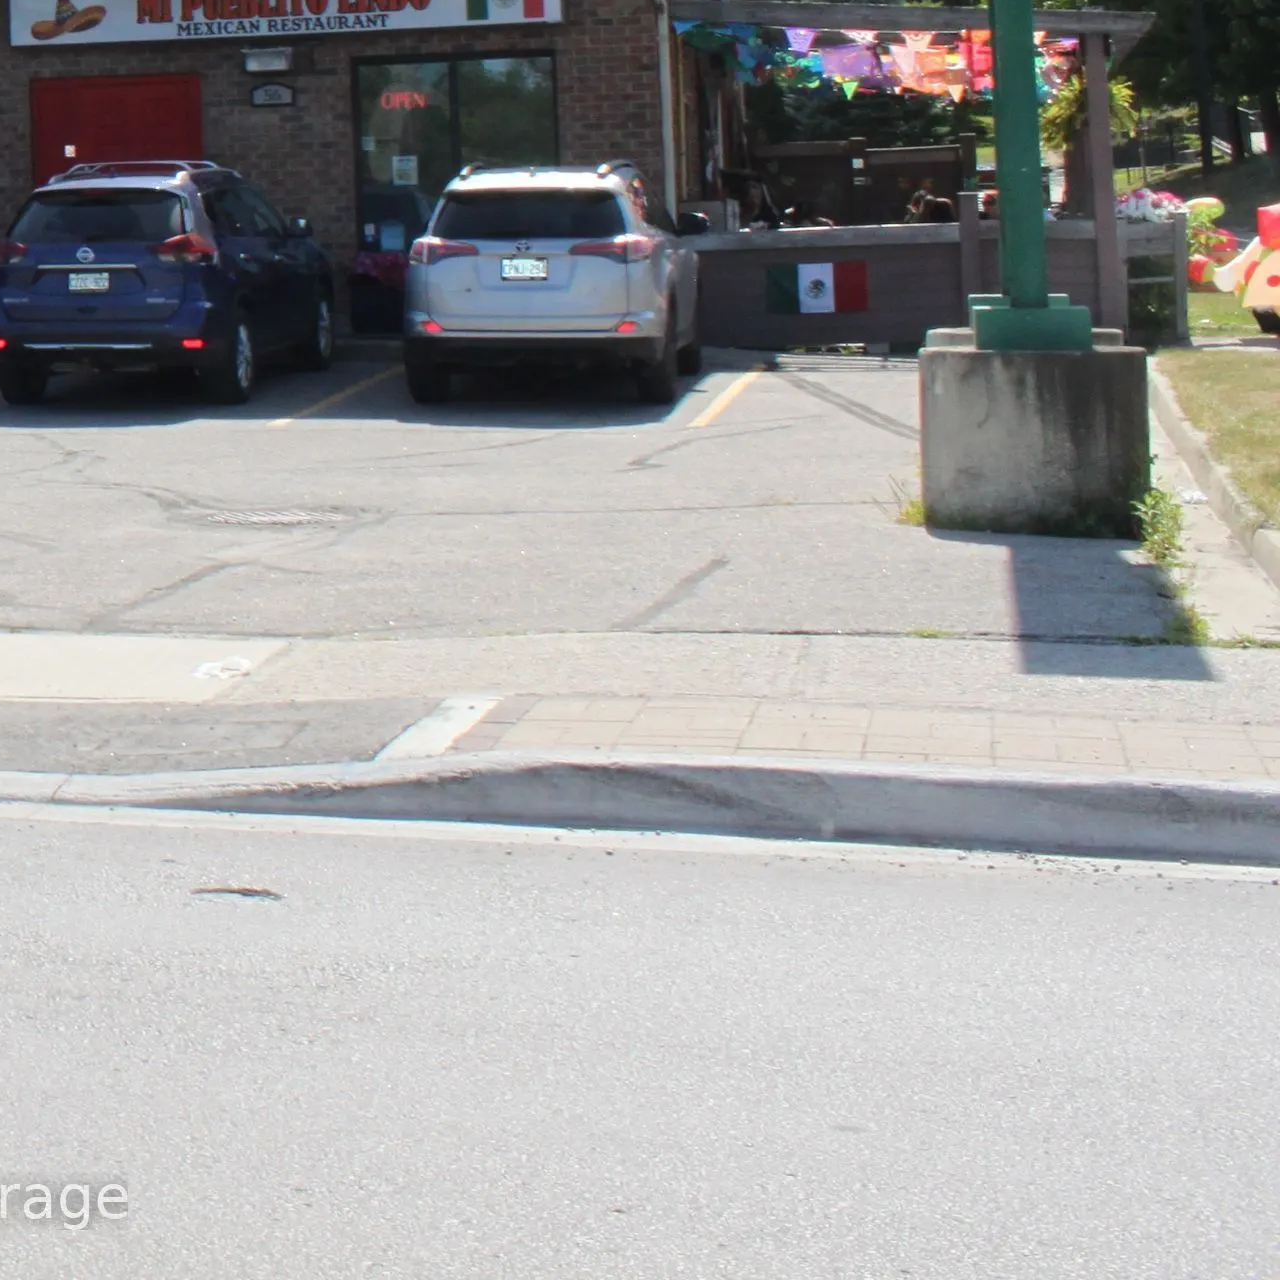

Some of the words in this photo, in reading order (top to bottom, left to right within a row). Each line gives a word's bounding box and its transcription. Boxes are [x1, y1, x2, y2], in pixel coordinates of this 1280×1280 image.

[177, 19, 260, 37] MEXICAN
[267, 14, 389, 33] RESTAURANT
[380, 90, 428, 110] OPEN
